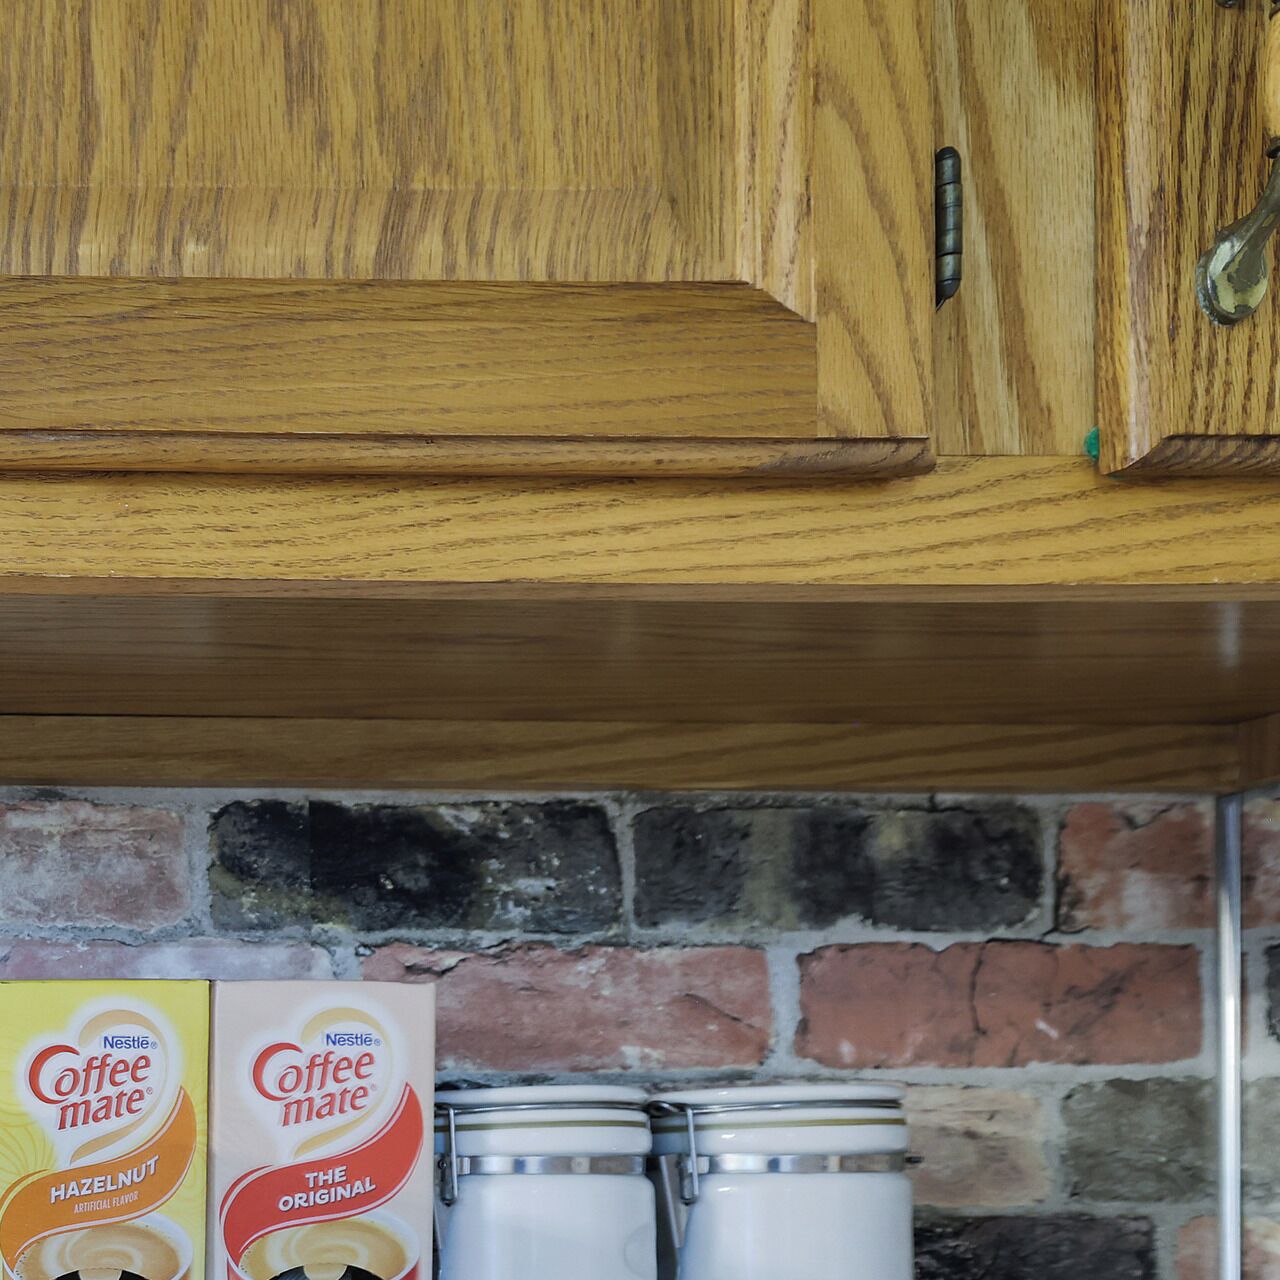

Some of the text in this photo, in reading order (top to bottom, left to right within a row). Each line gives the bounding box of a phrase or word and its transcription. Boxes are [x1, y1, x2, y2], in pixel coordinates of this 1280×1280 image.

[103, 1035, 149, 1049] Nestlé
[326, 1033, 373, 1046] Nestlé
[29, 1045, 151, 1104] Coffee
[252, 1042, 375, 1101] Coffee
[58, 1088, 145, 1130] mate
[282, 1085, 369, 1127] mate
[50, 1155, 160, 1204] HAZELNUT
[278, 1176, 377, 1212] ORIGINAL
[305, 1165, 347, 1189] THE
[74, 1191, 139, 1214] ARTIFICIAL FLAVOR
